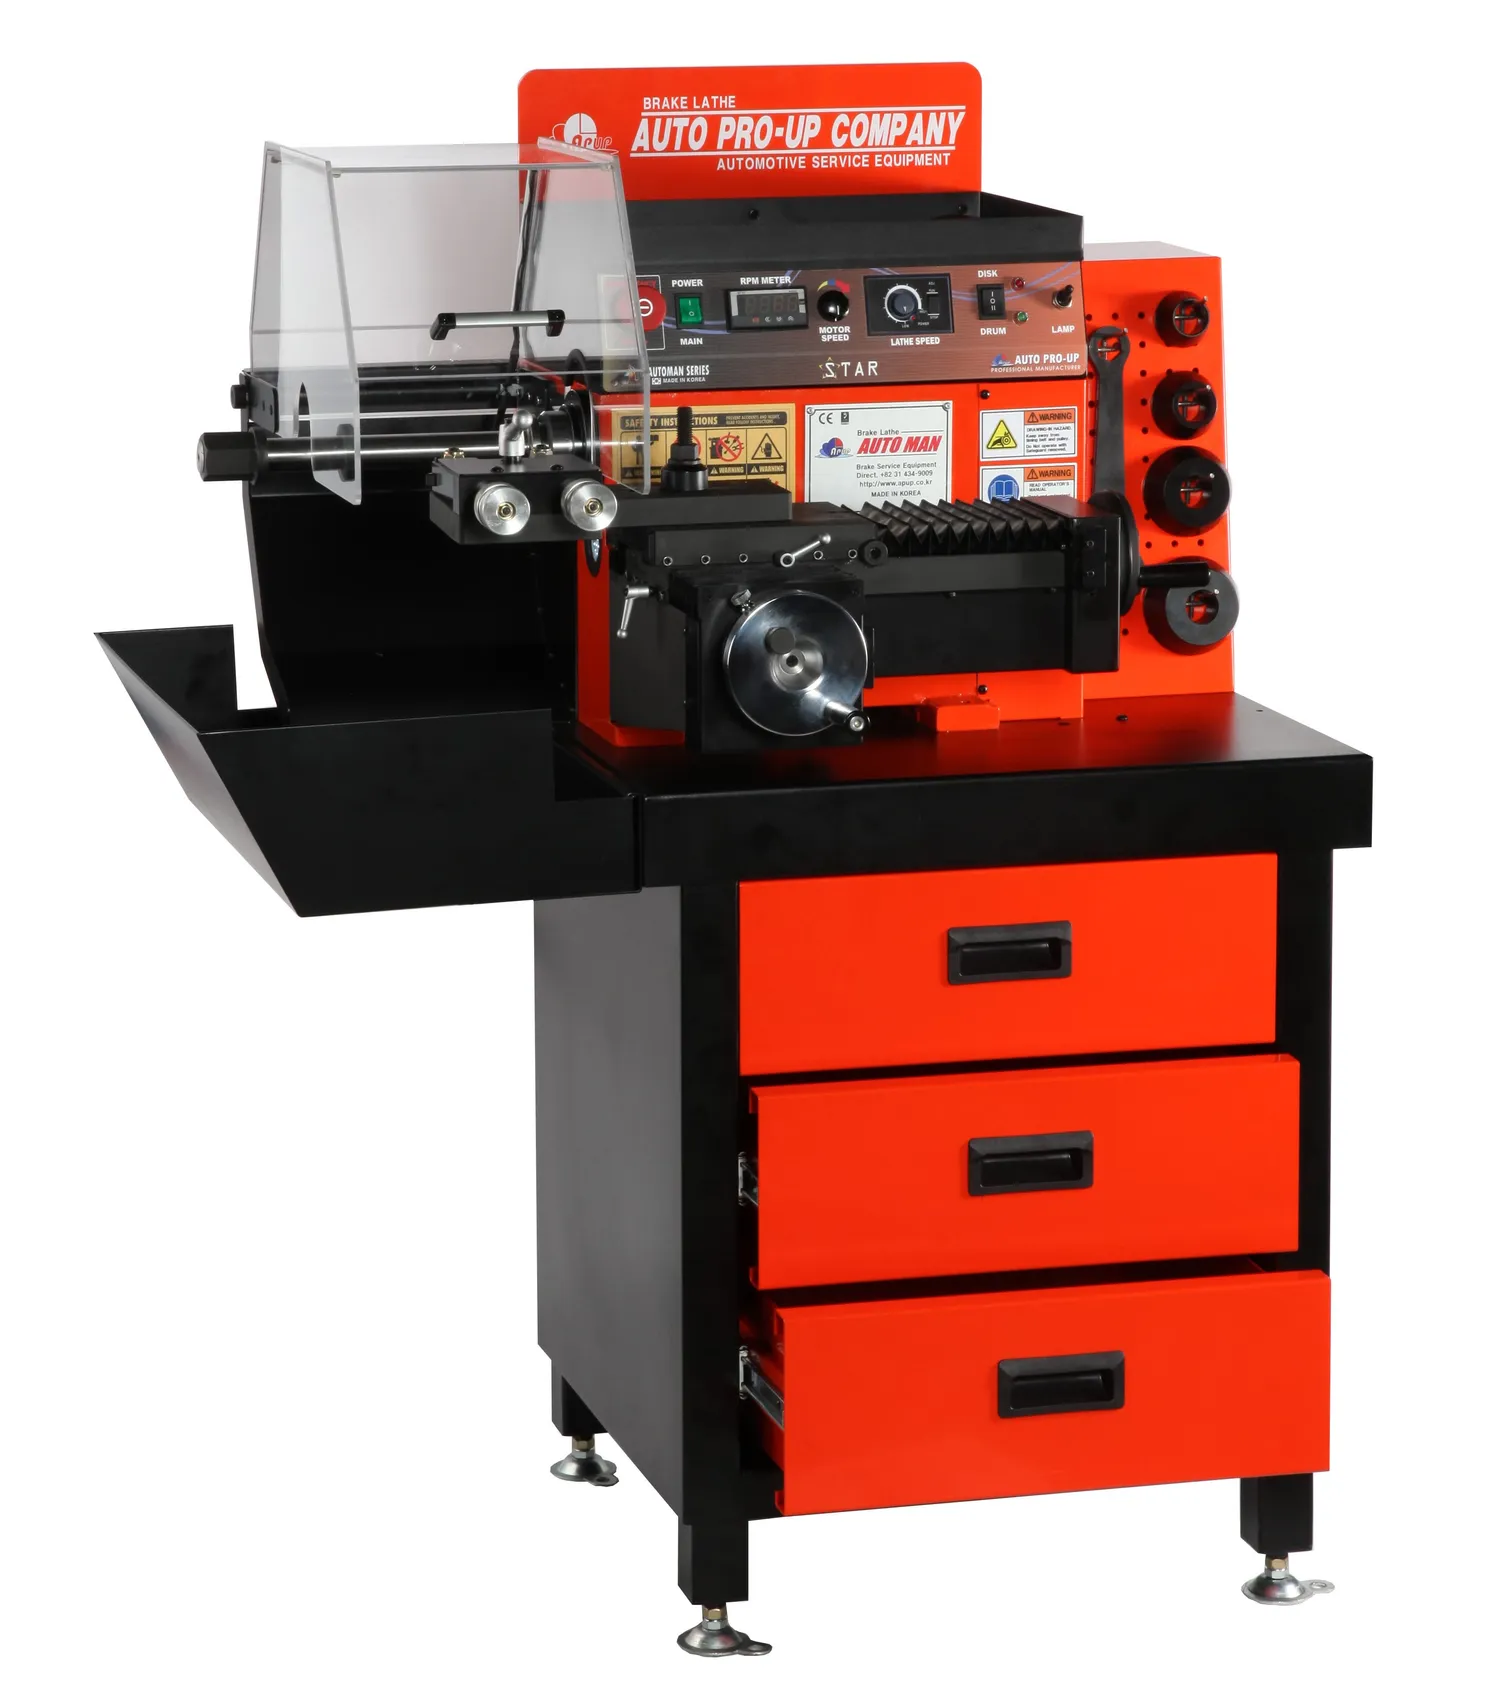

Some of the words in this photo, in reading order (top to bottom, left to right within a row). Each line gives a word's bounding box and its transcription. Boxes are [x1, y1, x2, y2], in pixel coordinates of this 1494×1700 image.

[643, 97, 688, 110] BRAKE
[693, 95, 736, 109] LATHE
[631, 116, 708, 151] AUTO
[716, 114, 821, 150] PRO-UP
[831, 111, 966, 148] COMPANY
[716, 156, 806, 171] AUTOMOTIVE
[811, 154, 870, 168] SERVICE
[874, 152, 951, 167] EQUIPMENT
[978, 270, 998, 278] DISK
[671, 279, 704, 287] POWER
[740, 277, 759, 285] RPM
[761, 276, 791, 284] METER
[819, 326, 851, 334] MOTOR
[980, 328, 1006, 336] DRUM
[821, 334, 850, 342] SPEED
[891, 338, 914, 346] LATHE
[915, 337, 940, 345] SPEED
[1015, 355, 1040, 365] AUTO
[1043, 353, 1080, 364] PRO-UP
[649, 366, 685, 377] AUTOMAN
[686, 365, 710, 376] SERIES
[825, 361, 878, 378] STAR
[1039, 412, 1072, 420] WARNING
[625, 418, 658, 428] SAFTY
[857, 436, 903, 455] AUTO
[903, 435, 943, 453] MAN
[719, 466, 744, 474] WARNING
[1039, 469, 1071, 477] WARNING
[860, 480, 932, 488] http://www.apup.co.kr
